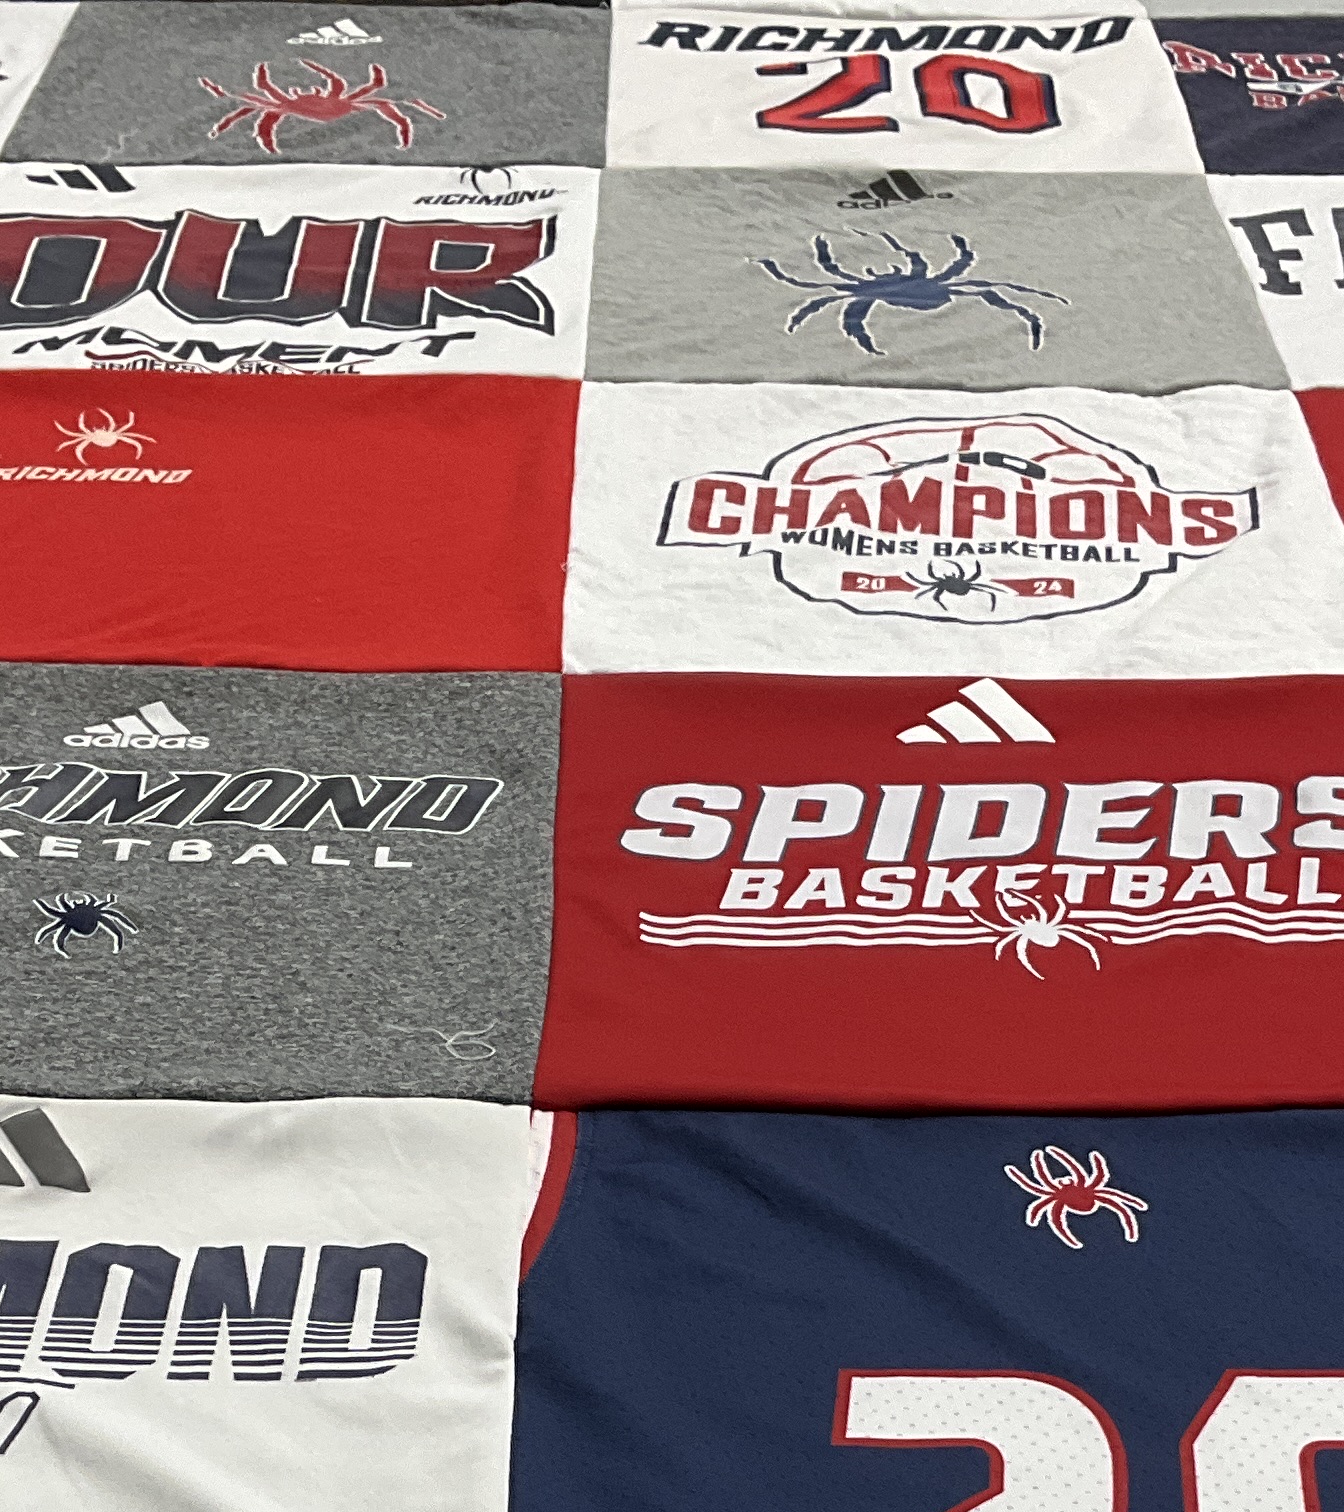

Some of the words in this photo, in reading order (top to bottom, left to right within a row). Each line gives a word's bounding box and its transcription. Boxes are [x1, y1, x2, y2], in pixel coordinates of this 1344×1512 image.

[637, 16, 1134, 53] RICHMOND
[756, 54, 1062, 134] 20
[687, 476, 1239, 547] CHAMPIONS
[933, 540, 1140, 563] BASKETBALL
[855, 576, 887, 592] 20
[64, 729, 210, 750] adidas
[718, 857, 1343, 911] BASKETBALL
